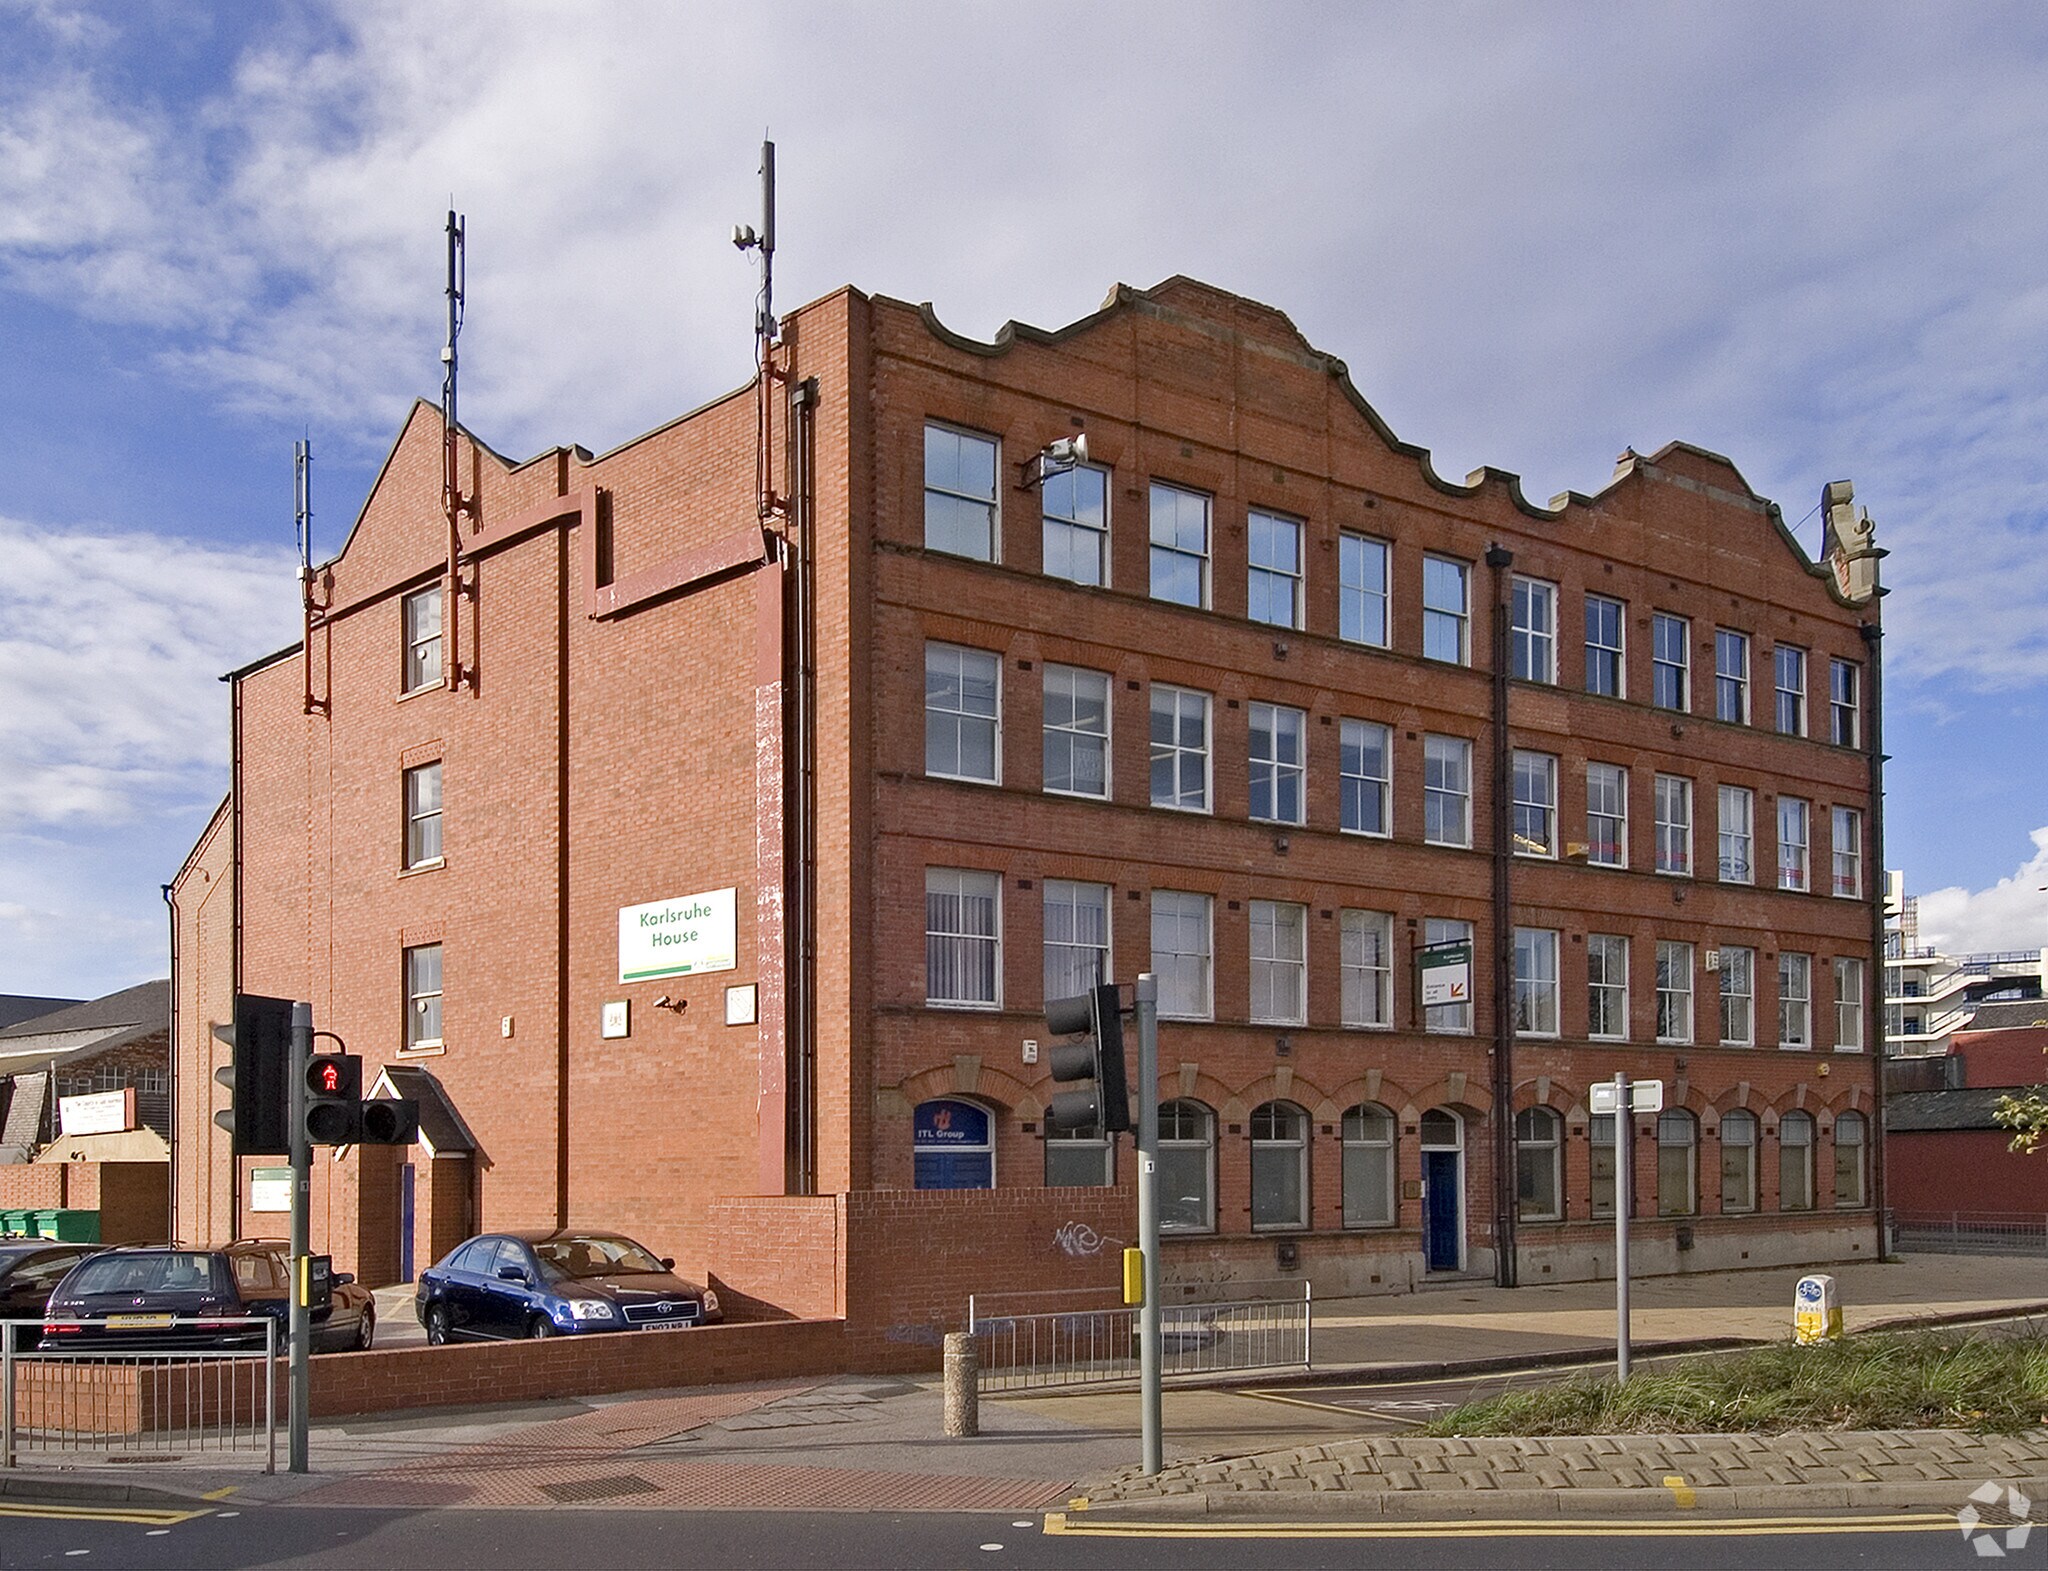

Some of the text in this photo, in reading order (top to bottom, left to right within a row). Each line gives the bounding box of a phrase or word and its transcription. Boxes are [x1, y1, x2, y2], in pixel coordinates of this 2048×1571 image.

[640, 902, 712, 927] Karlsruhe
[652, 930, 698, 947] House
[918, 1130, 965, 1140] ITL Group
